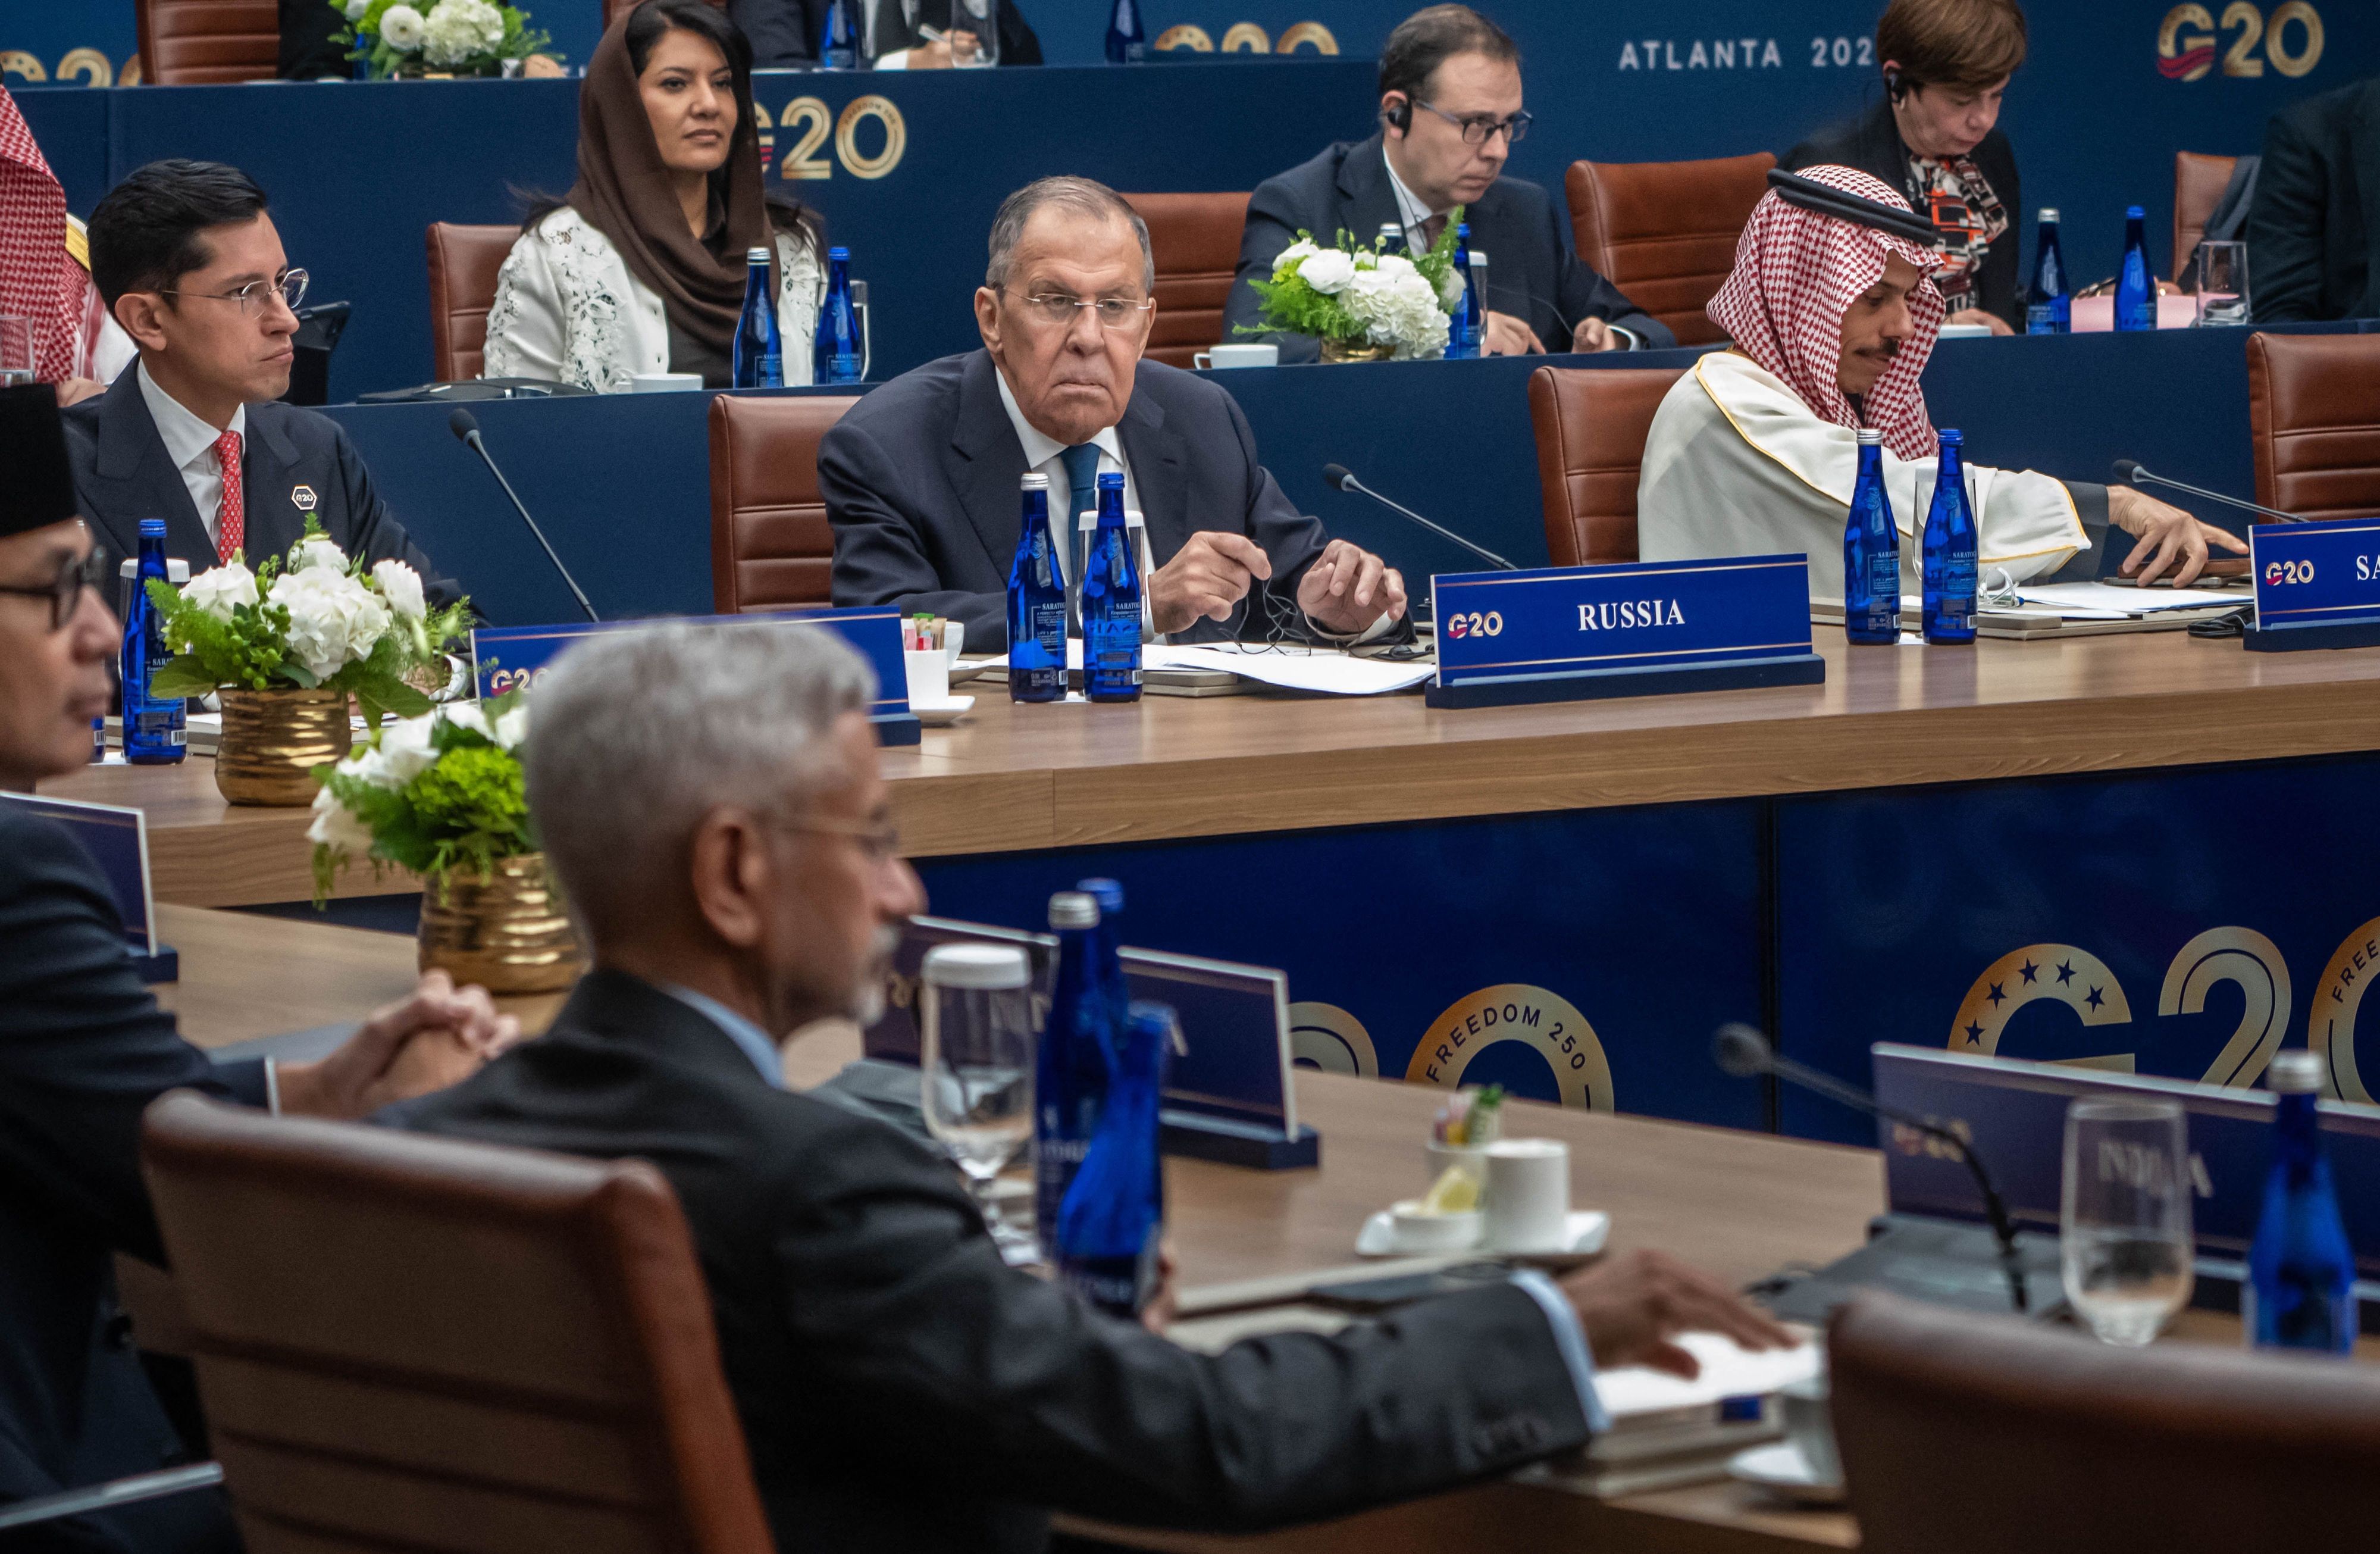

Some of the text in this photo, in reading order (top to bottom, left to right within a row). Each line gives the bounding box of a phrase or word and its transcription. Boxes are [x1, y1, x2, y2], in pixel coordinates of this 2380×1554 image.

[1618, 37, 1872, 70] ATLANTA 202
[2157, 1, 2325, 82] G20
[2265, 559, 2314, 586] G20
[1448, 599, 1686, 639] G20 RUSSIA
[2332, 939, 2379, 1003] FREE
[1426, 1003, 1541, 1083] FREEDOM
[1549, 1022, 1586, 1070] 250
